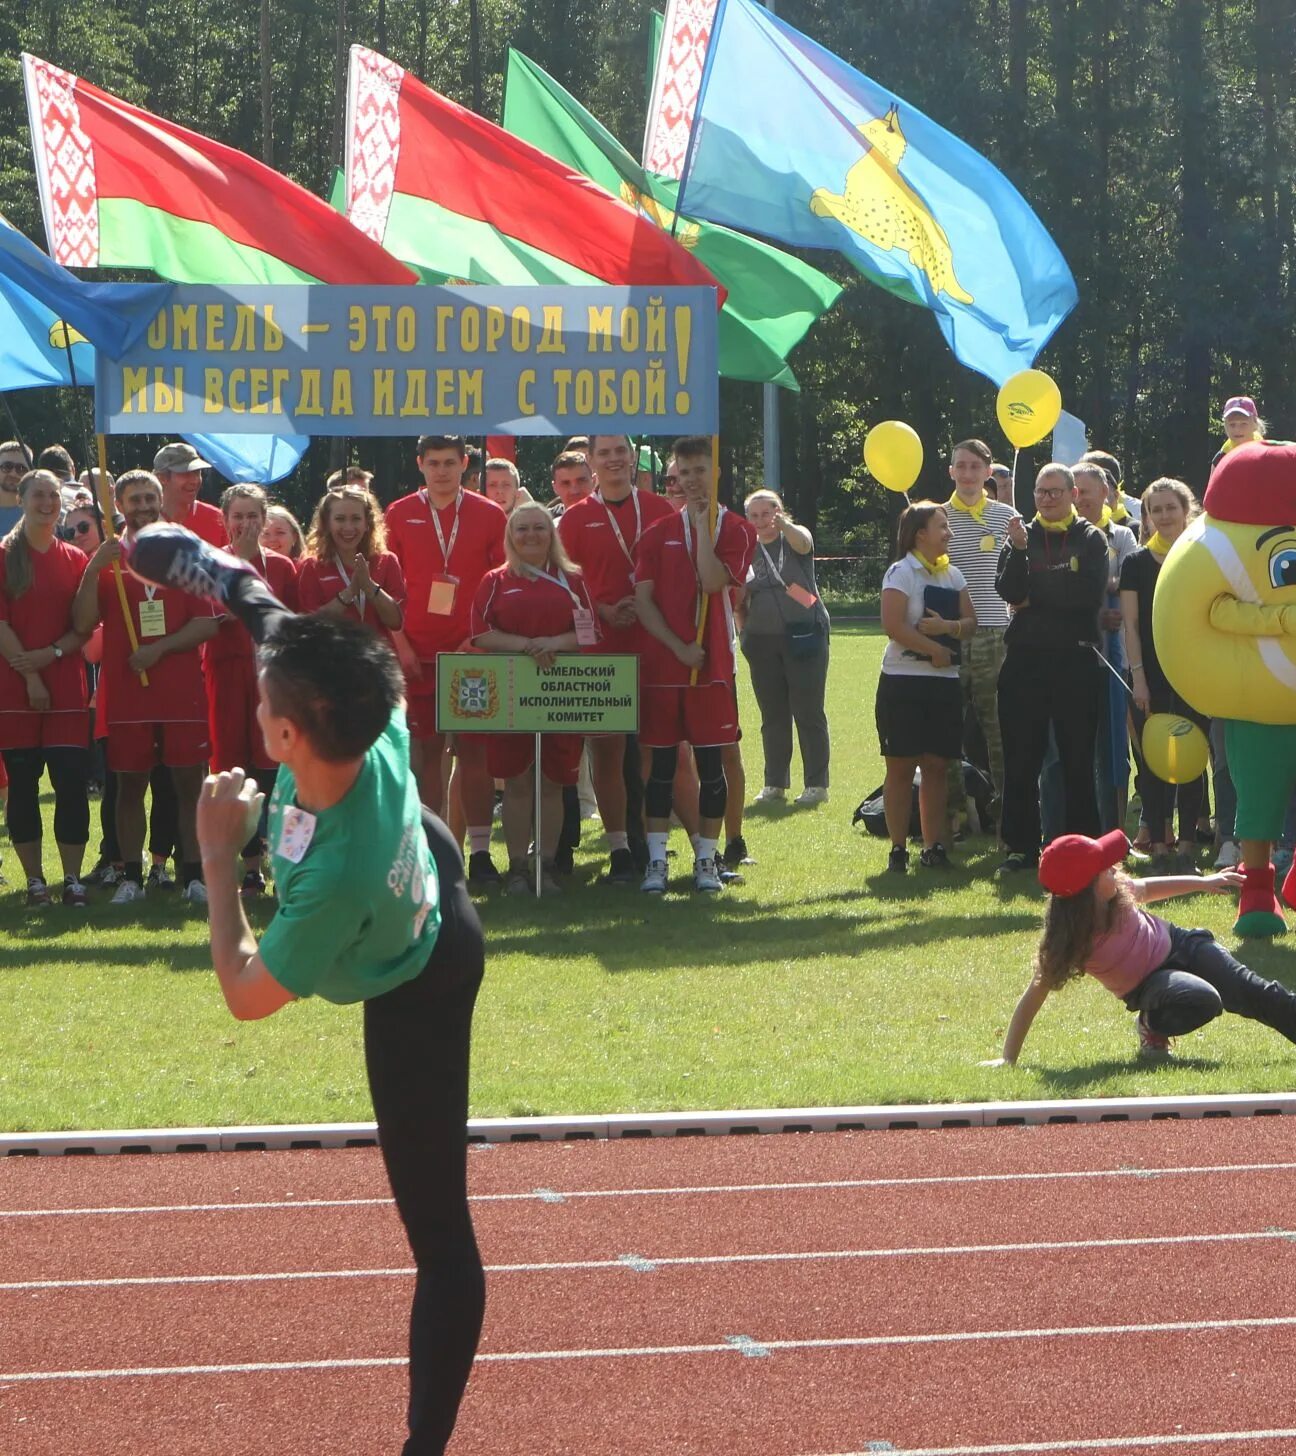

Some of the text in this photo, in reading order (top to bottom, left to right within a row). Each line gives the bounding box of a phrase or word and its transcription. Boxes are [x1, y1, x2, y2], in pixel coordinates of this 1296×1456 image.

[147, 304, 284, 351] ОМЕЛЬ
[349, 305, 416, 352] ЭТО
[436, 305, 566, 354] ГОРОД
[122, 366, 184, 413] МЫ
[204, 368, 354, 417] ВСЕГДА
[372, 369, 483, 417] ИДЕМ
[518, 369, 536, 415] С
[541, 680, 611, 692] ОБЛАСТНОЙ
[519, 695, 632, 707] ИСПОЛНИТЕЛЬНЫЙ
[547, 711, 604, 722] КОМИТЕТ
